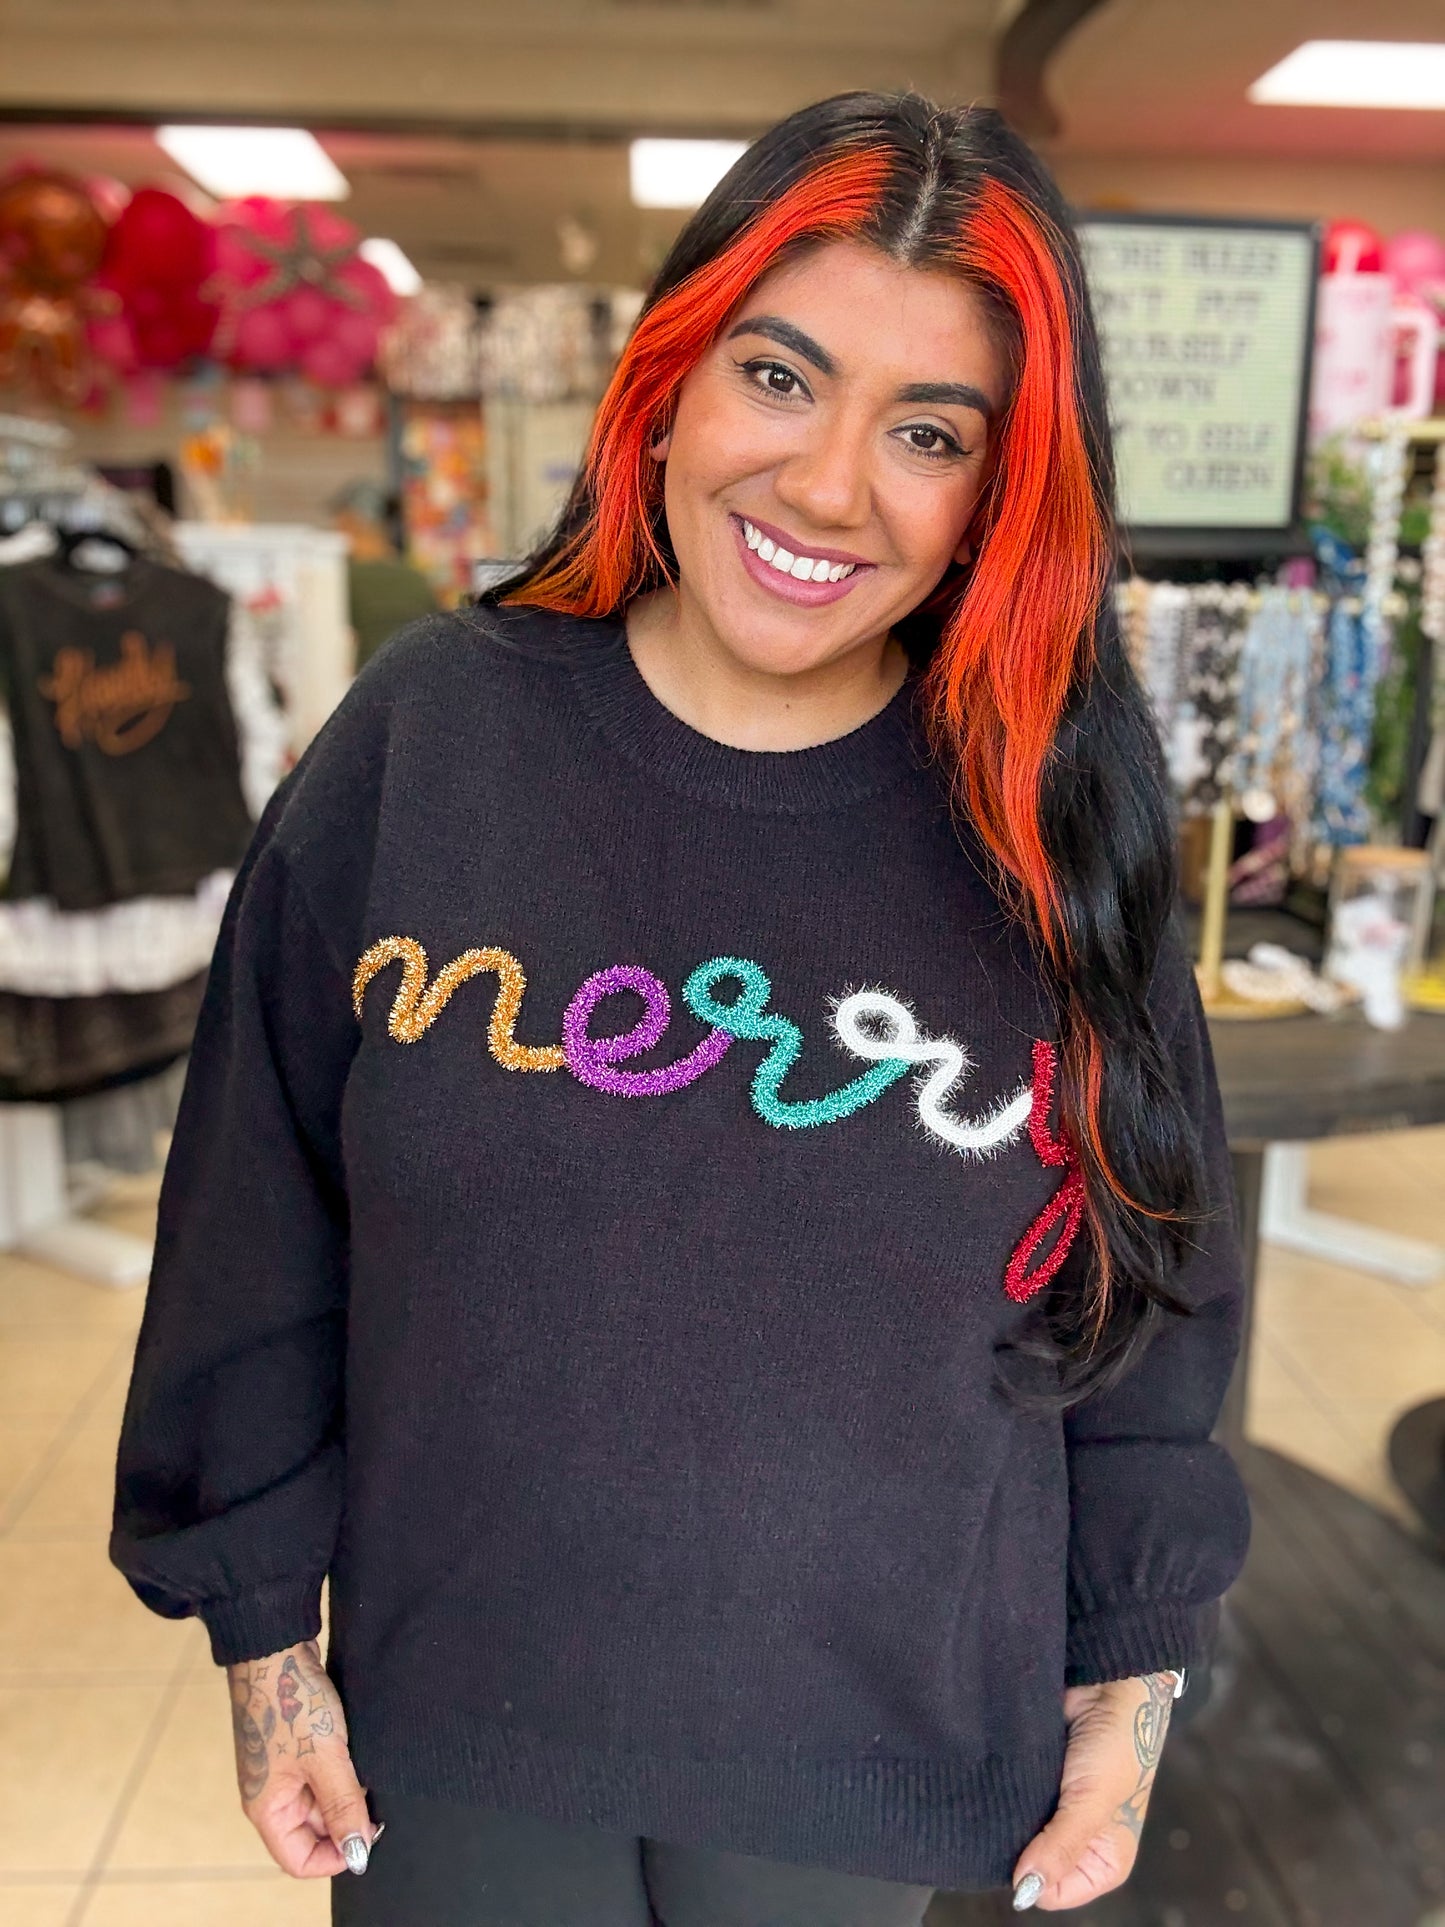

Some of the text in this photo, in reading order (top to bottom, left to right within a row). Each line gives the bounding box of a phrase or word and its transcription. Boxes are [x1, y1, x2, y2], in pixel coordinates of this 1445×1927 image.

[1084, 241, 1170, 276] ORE
[1101, 331, 1253, 367] OURSELF
[352, 934, 1085, 1304] merry
